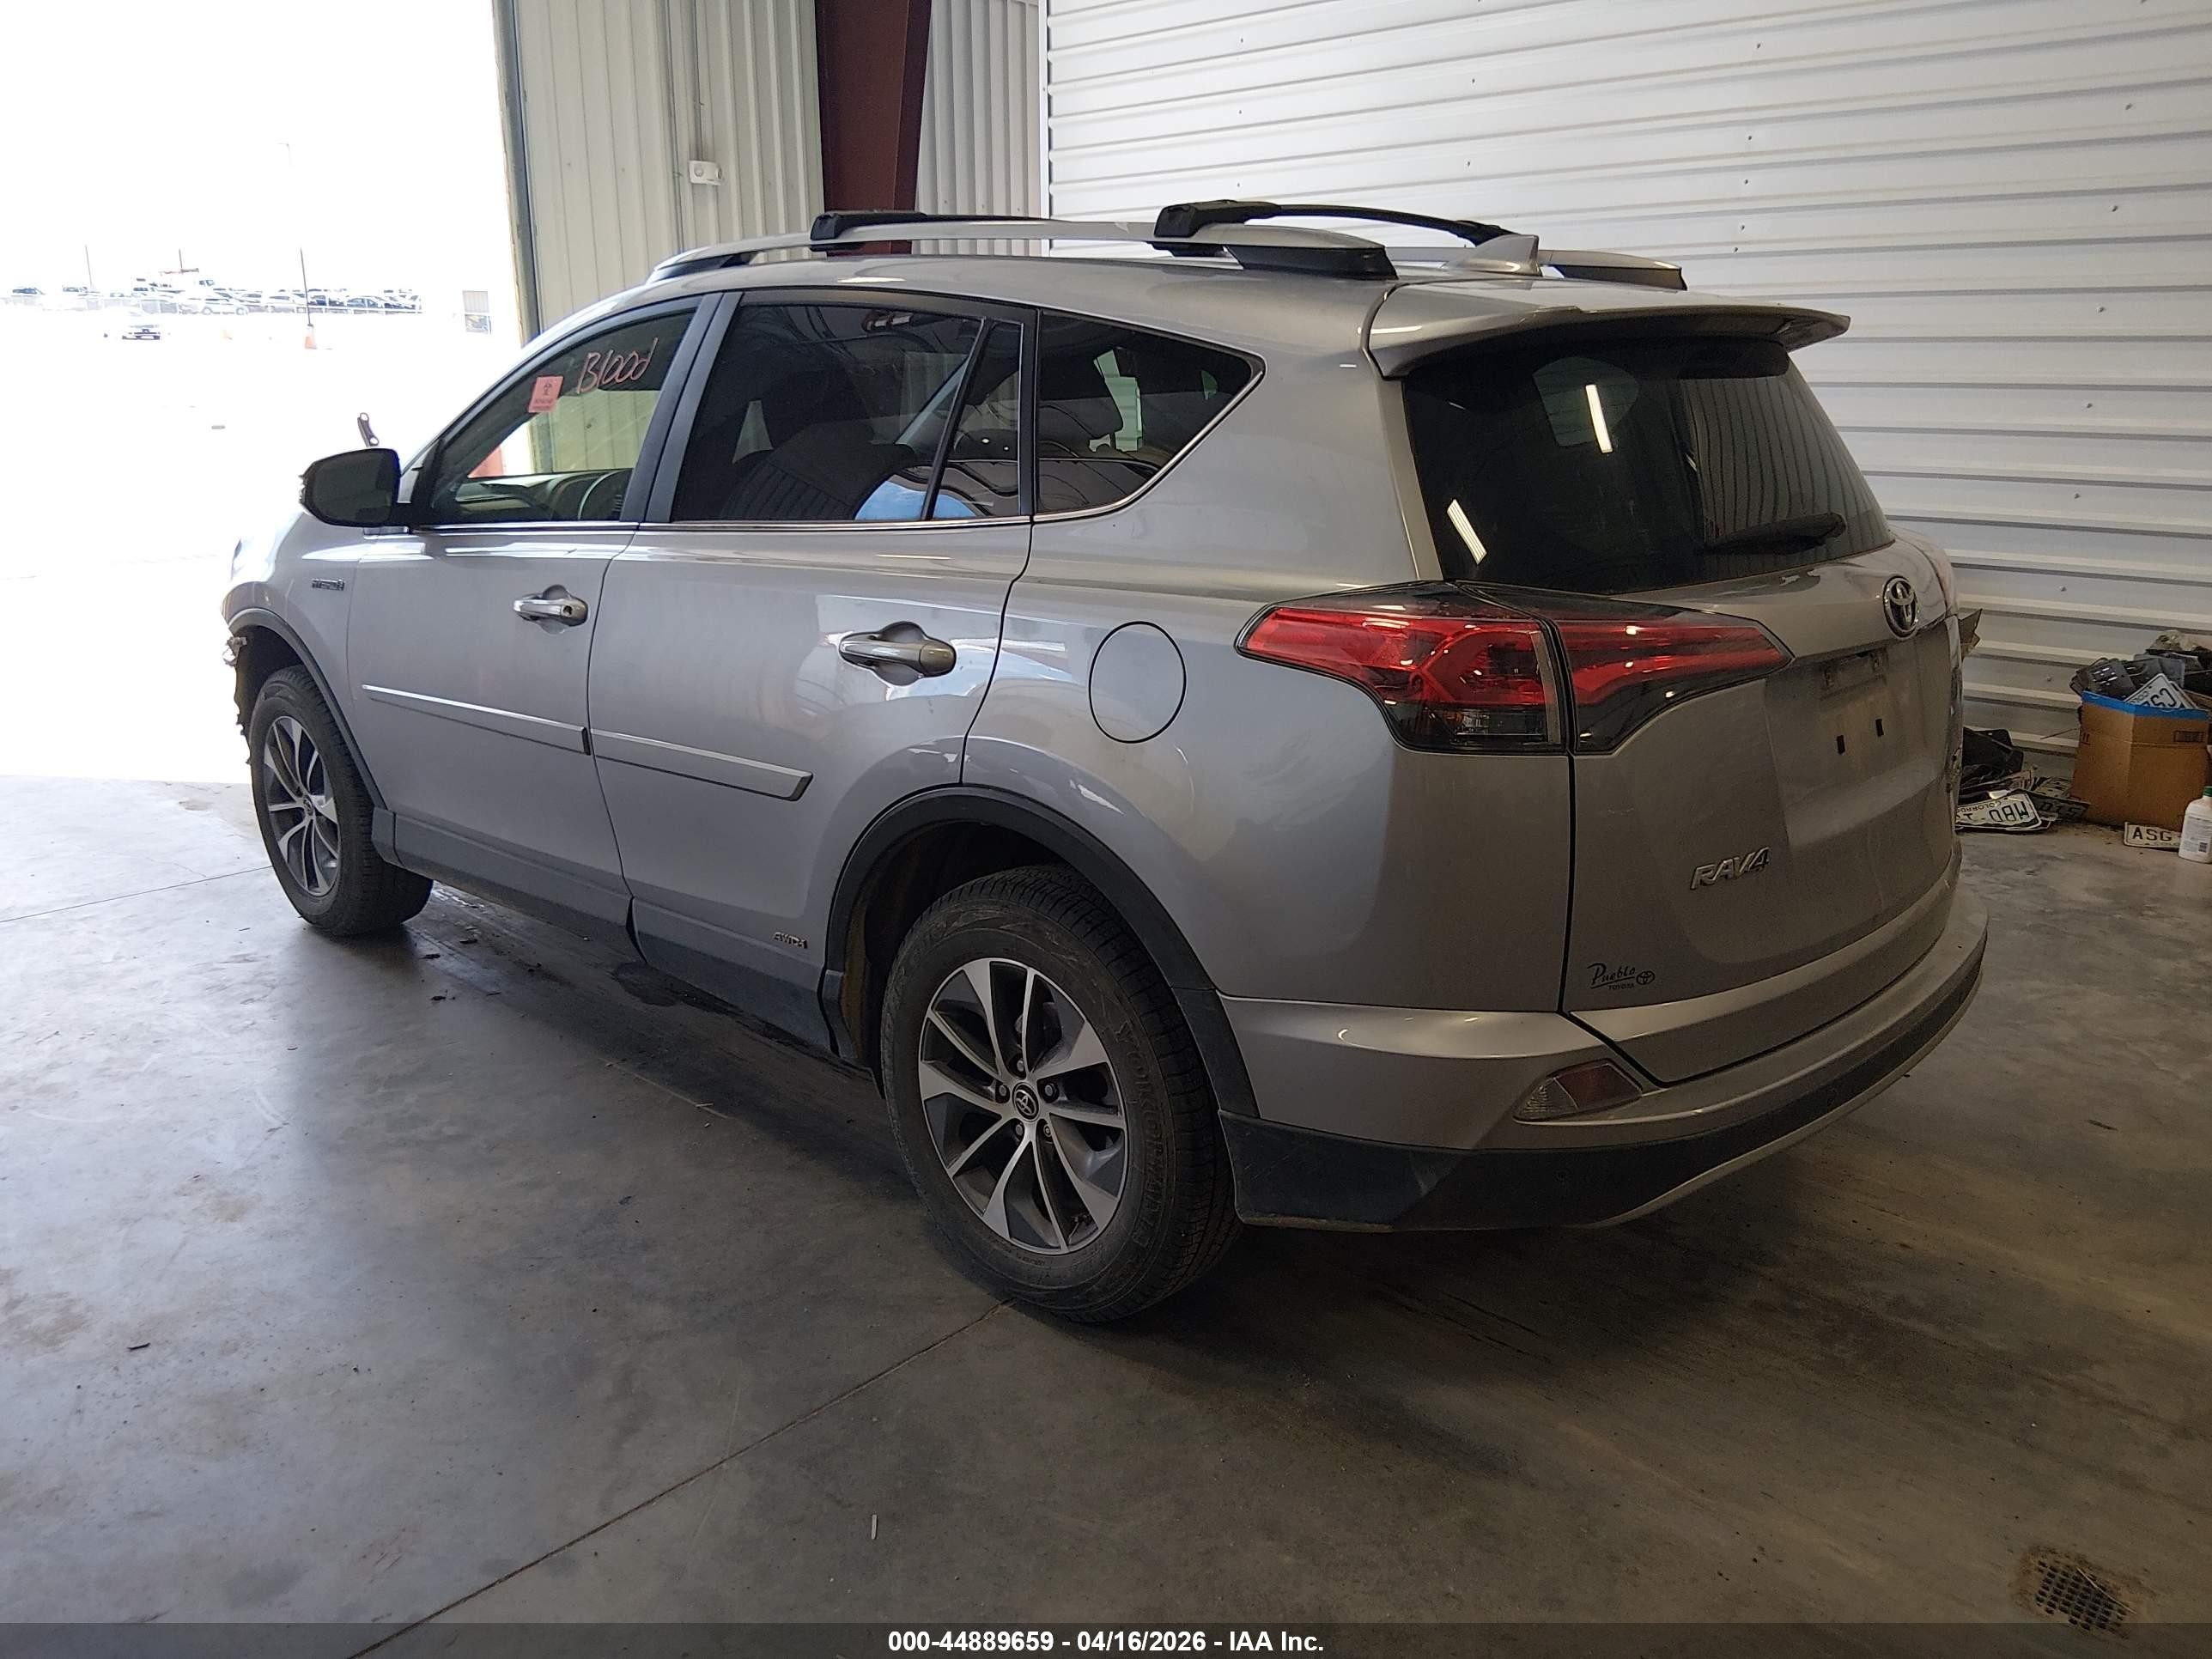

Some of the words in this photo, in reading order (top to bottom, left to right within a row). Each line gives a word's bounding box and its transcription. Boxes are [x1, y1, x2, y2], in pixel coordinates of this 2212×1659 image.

[576, 337, 659, 394] Blood
[1957, 799, 2002, 812] COLORAD
[1690, 847, 1771, 890] RAV4
[1587, 963, 1635, 985] Pueblo
